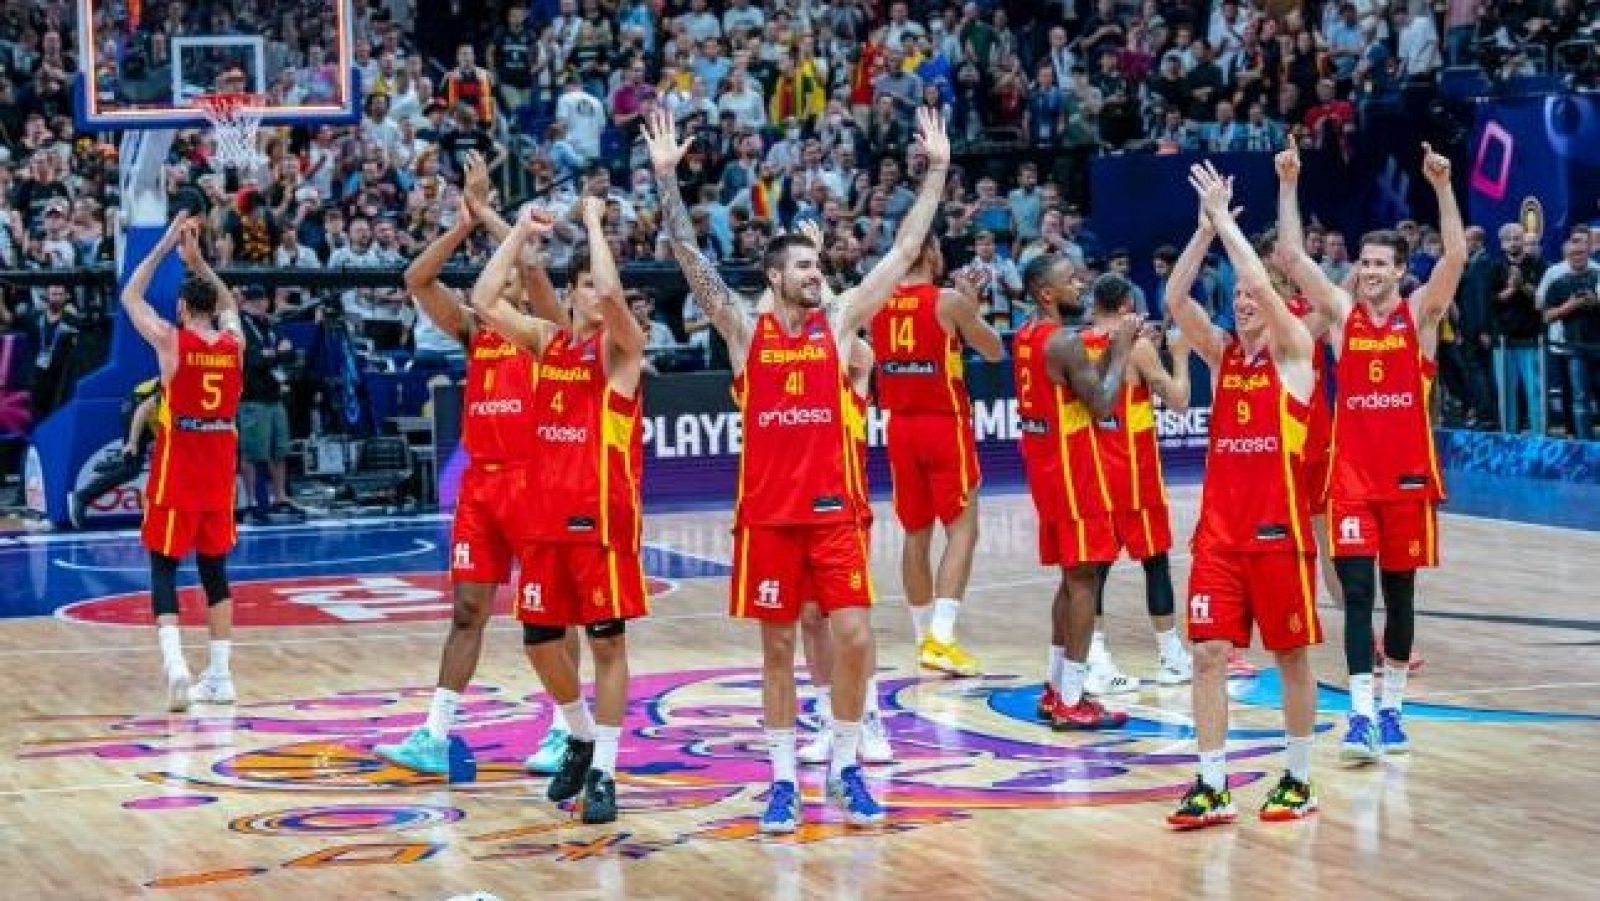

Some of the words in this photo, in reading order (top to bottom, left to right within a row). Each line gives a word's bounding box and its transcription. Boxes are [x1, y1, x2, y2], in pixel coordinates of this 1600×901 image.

[889, 316, 915, 353] 14
[760, 345, 827, 363] ESPAÑA
[1368, 359, 1384, 383] 6
[201, 372, 224, 411] 5
[785, 370, 805, 396] 41
[550, 390, 564, 413] 4
[1237, 400, 1251, 424] 9
[1346, 391, 1412, 410] endesa
[758, 405, 832, 427] endesa
[537, 424, 587, 442] ndesa
[1216, 437, 1279, 453] endesa
